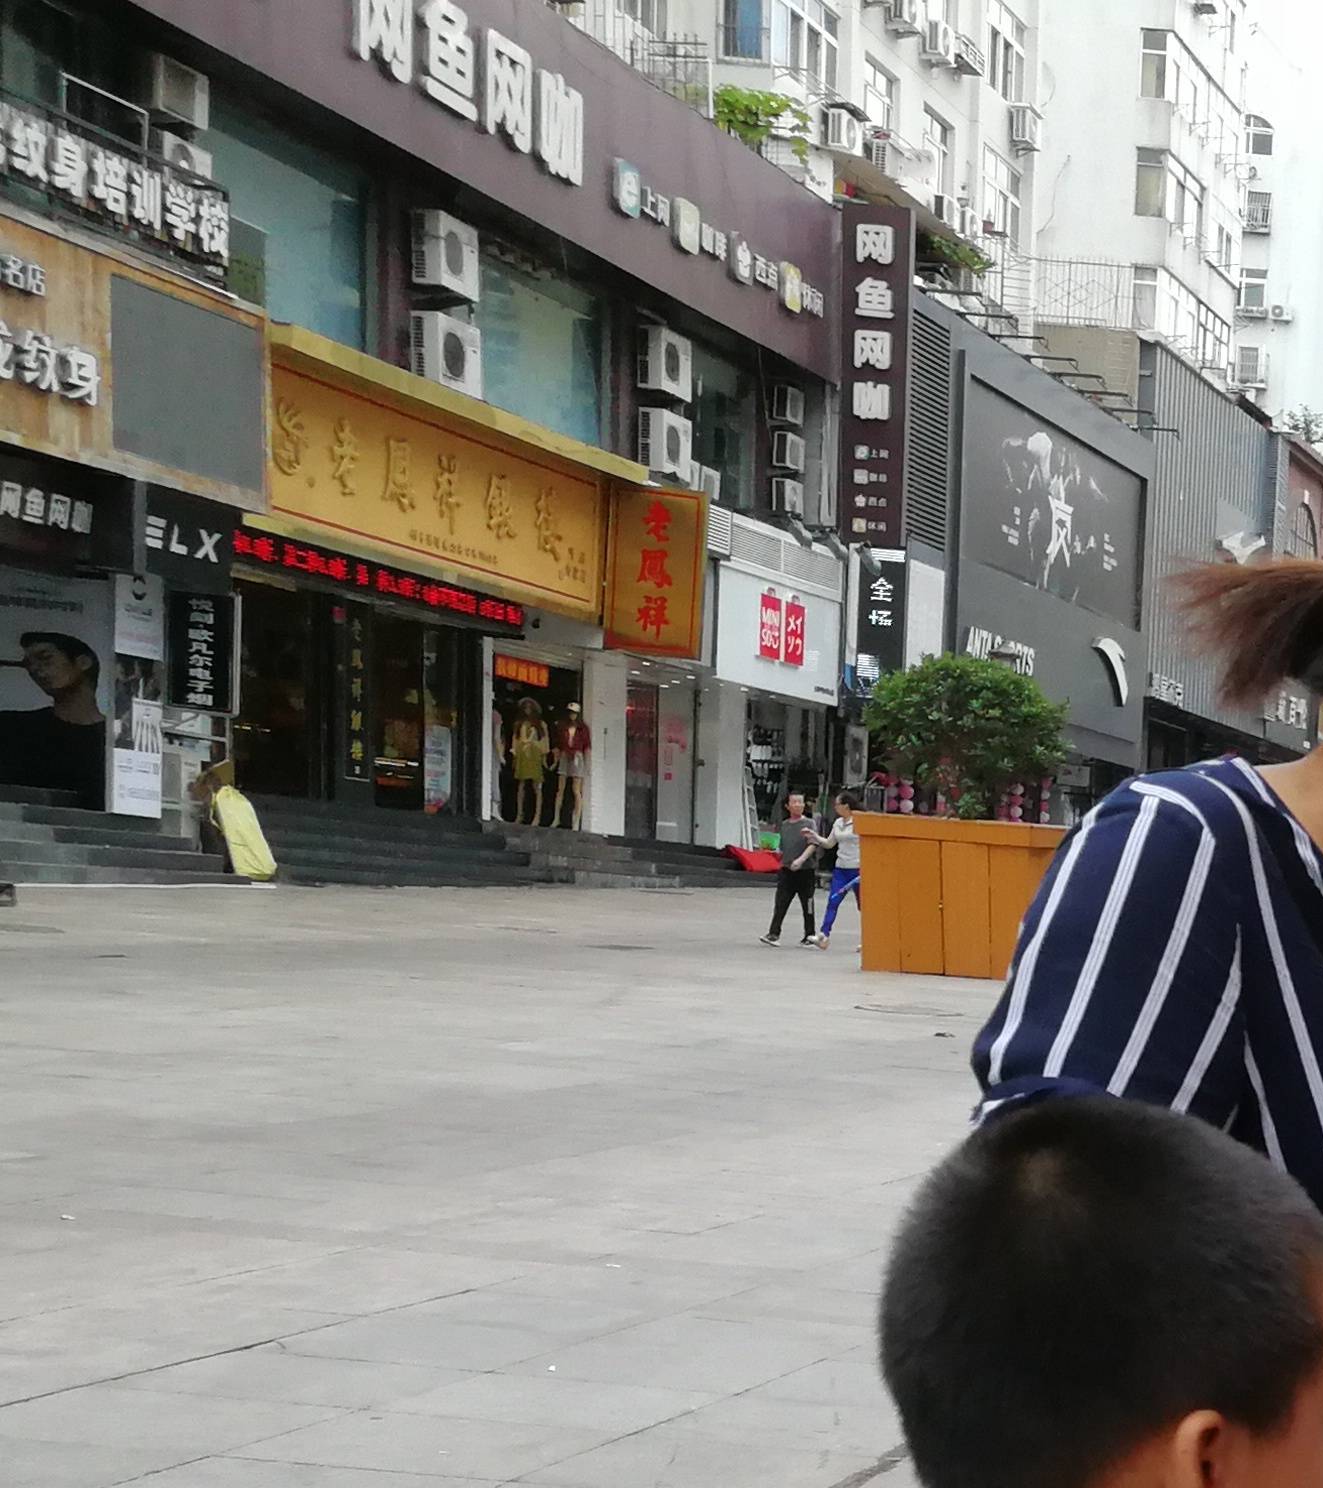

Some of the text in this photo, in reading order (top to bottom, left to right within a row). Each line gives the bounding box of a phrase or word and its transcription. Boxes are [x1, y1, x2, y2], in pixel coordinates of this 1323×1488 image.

[356, 0, 584, 187] 网鱼网咖
[0, 104, 229, 266] 纹身培训学校
[851, 223, 896, 421] 网鱼网咖
[145, 515, 223, 563] ELX
[994, 635, 1036, 677] SRTS
